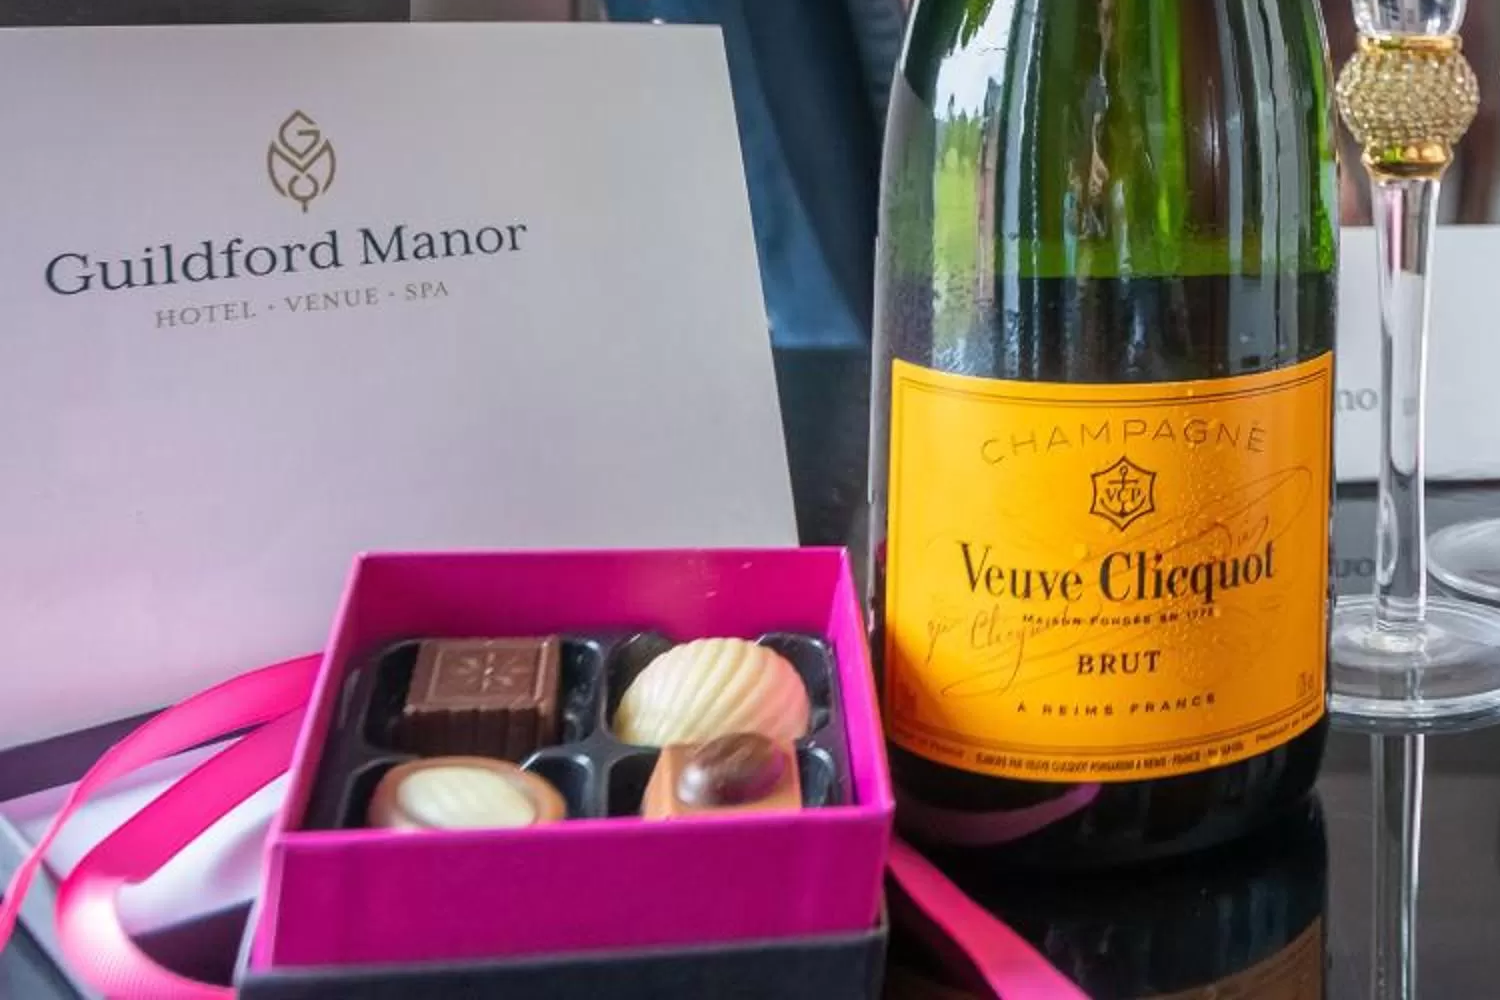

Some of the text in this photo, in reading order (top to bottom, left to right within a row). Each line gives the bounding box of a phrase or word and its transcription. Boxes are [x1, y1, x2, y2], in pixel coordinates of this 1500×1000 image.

[44, 222, 528, 296] Guildford Manor
[154, 280, 449, 330] HOTEL VENUE SPA
[980, 418, 1267, 466] CHAMPAGNE
[1104, 486, 1142, 502] VCP
[955, 539, 1276, 605] Veuve Clicquot
[1076, 650, 1162, 676] BRUT
[1041, 702, 1114, 717] REIMS
[1128, 691, 1217, 715] FRANCE
